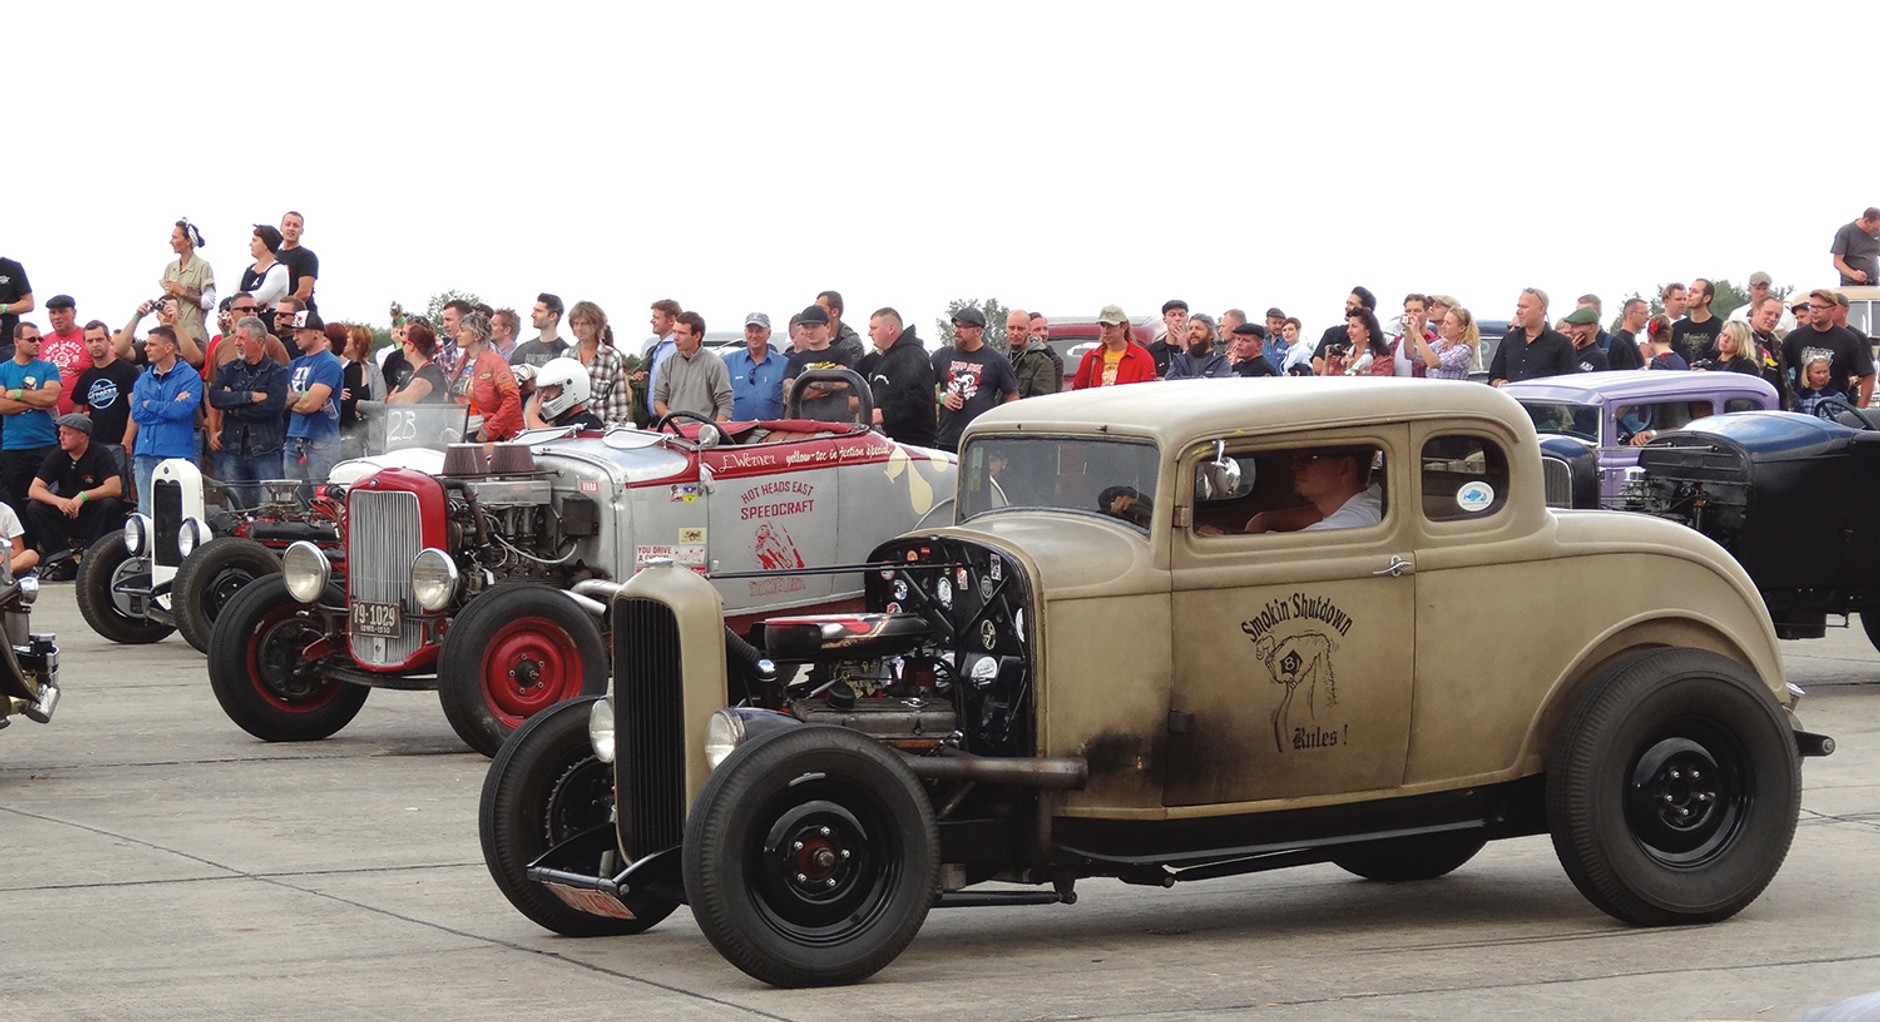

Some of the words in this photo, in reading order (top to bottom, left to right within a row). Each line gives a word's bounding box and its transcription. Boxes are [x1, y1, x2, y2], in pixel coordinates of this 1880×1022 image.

[740, 487, 760, 504] HOT
[761, 481, 791, 495] HEADS
[792, 481, 814, 496] EAST
[740, 499, 815, 520] SPEEDCRAFT
[637, 546, 651, 554] YOU
[653, 546, 672, 554] DRIVE
[1293, 593, 1353, 637] Shutdown
